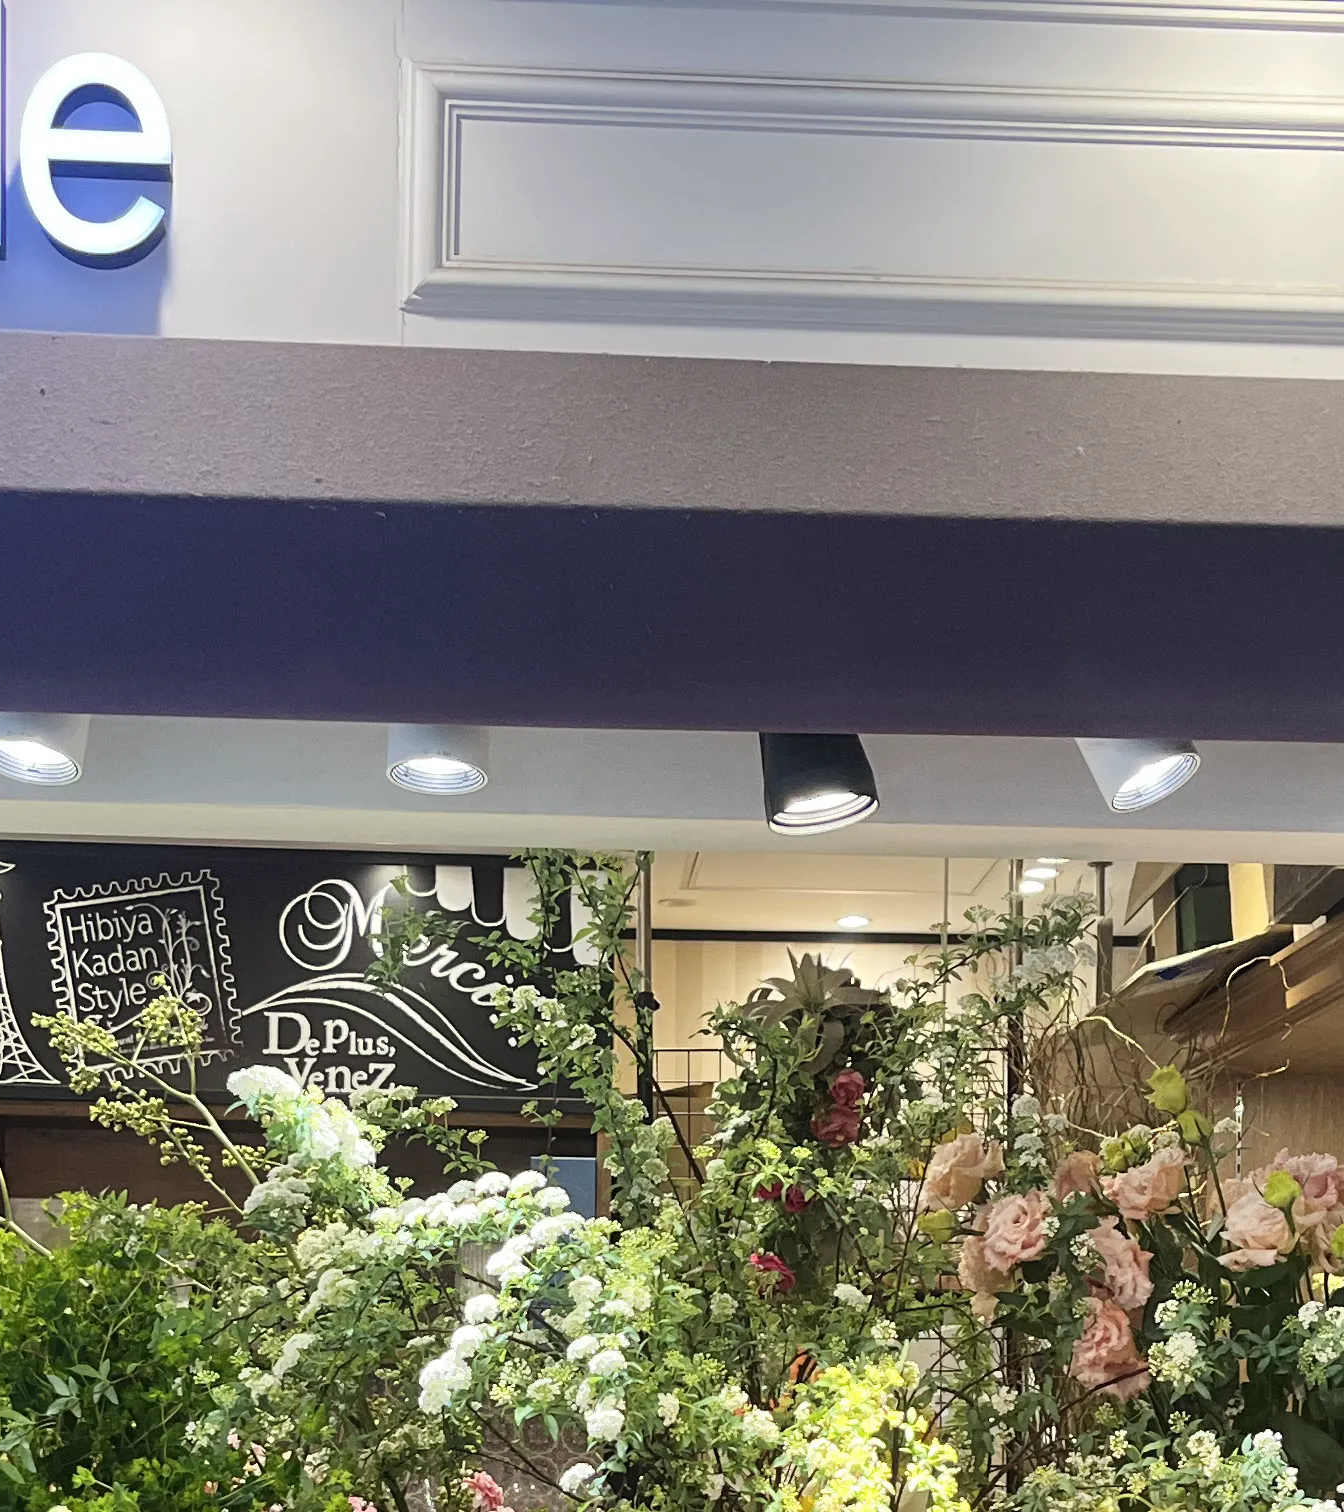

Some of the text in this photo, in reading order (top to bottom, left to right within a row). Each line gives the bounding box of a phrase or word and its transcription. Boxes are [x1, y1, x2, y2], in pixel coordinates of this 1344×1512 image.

[66, 909, 154, 944] Hibiya
[72, 944, 159, 979] Kadan
[77, 977, 147, 1018] Style
